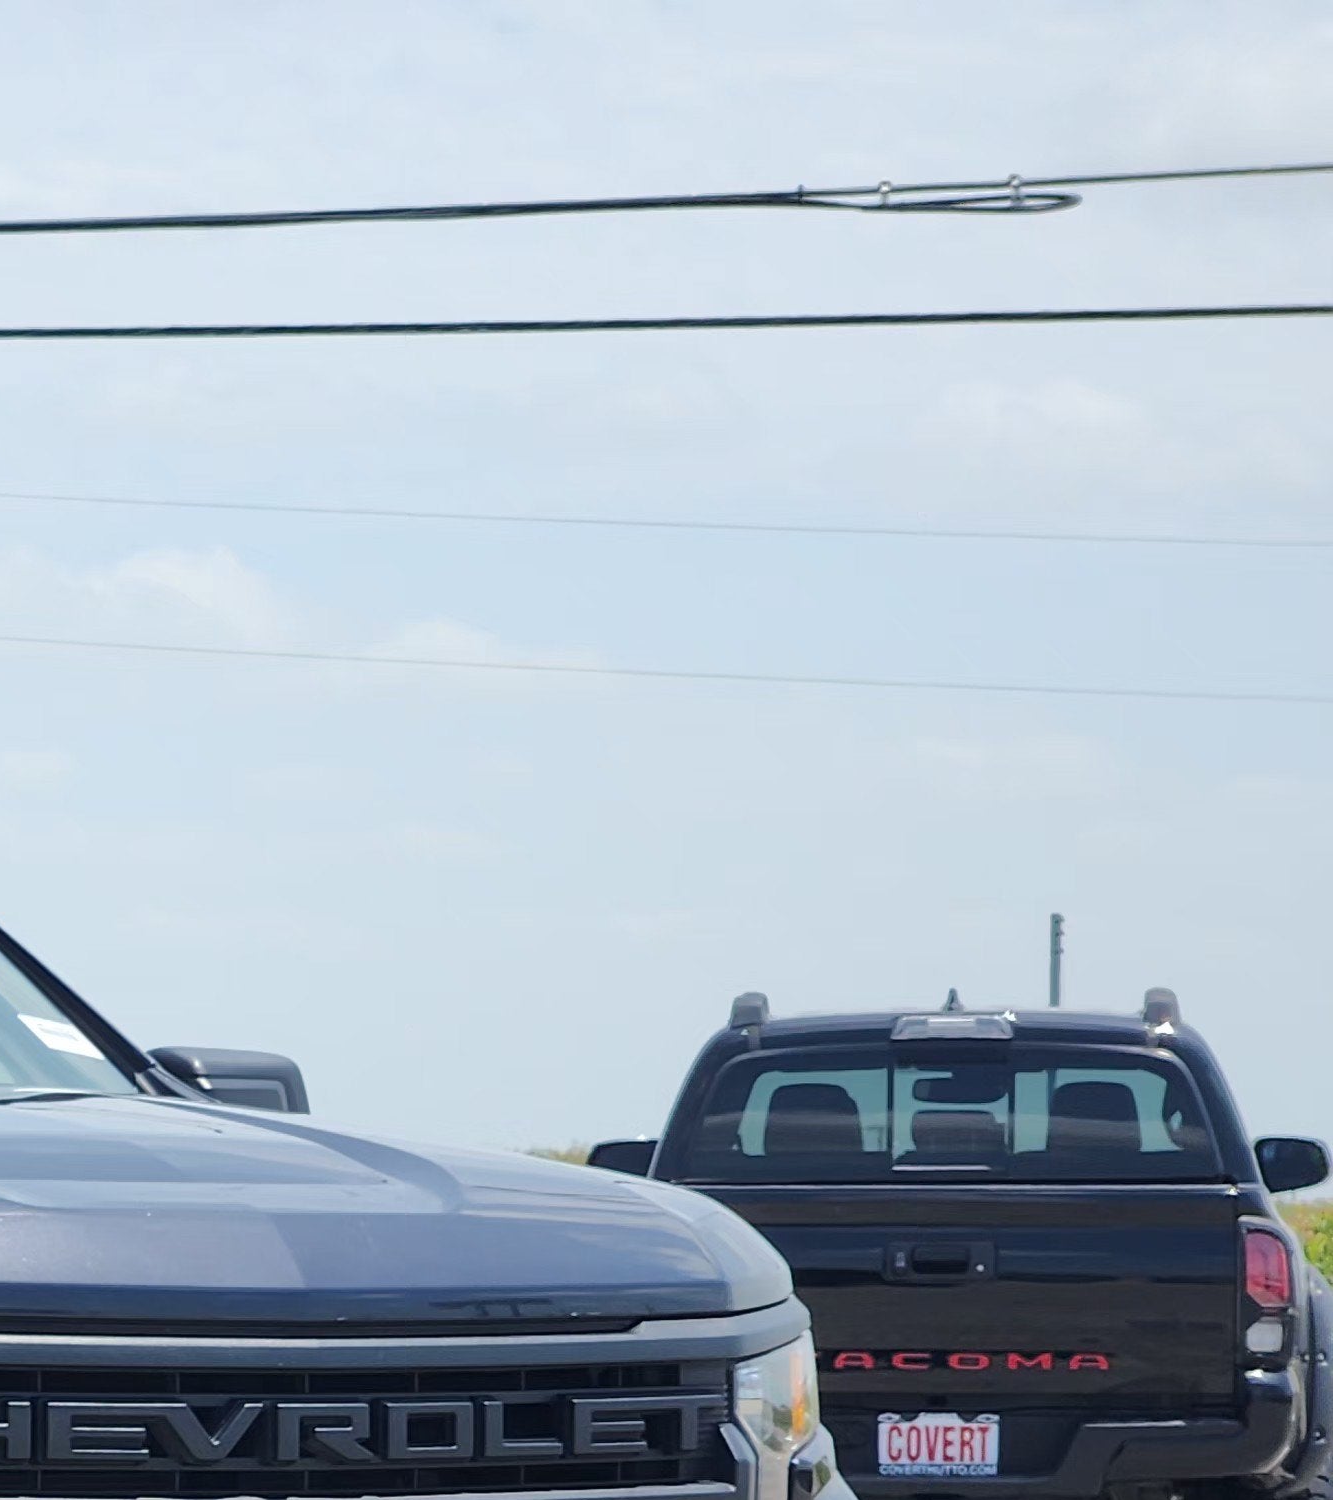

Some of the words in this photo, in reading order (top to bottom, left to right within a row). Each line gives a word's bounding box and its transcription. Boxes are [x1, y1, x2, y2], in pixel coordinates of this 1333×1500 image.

[816, 1352, 1110, 1371] ACOMA
[887, 1425, 990, 1462] COVERT
[878, 1464, 998, 1476] COVERTHUTTO.COM
